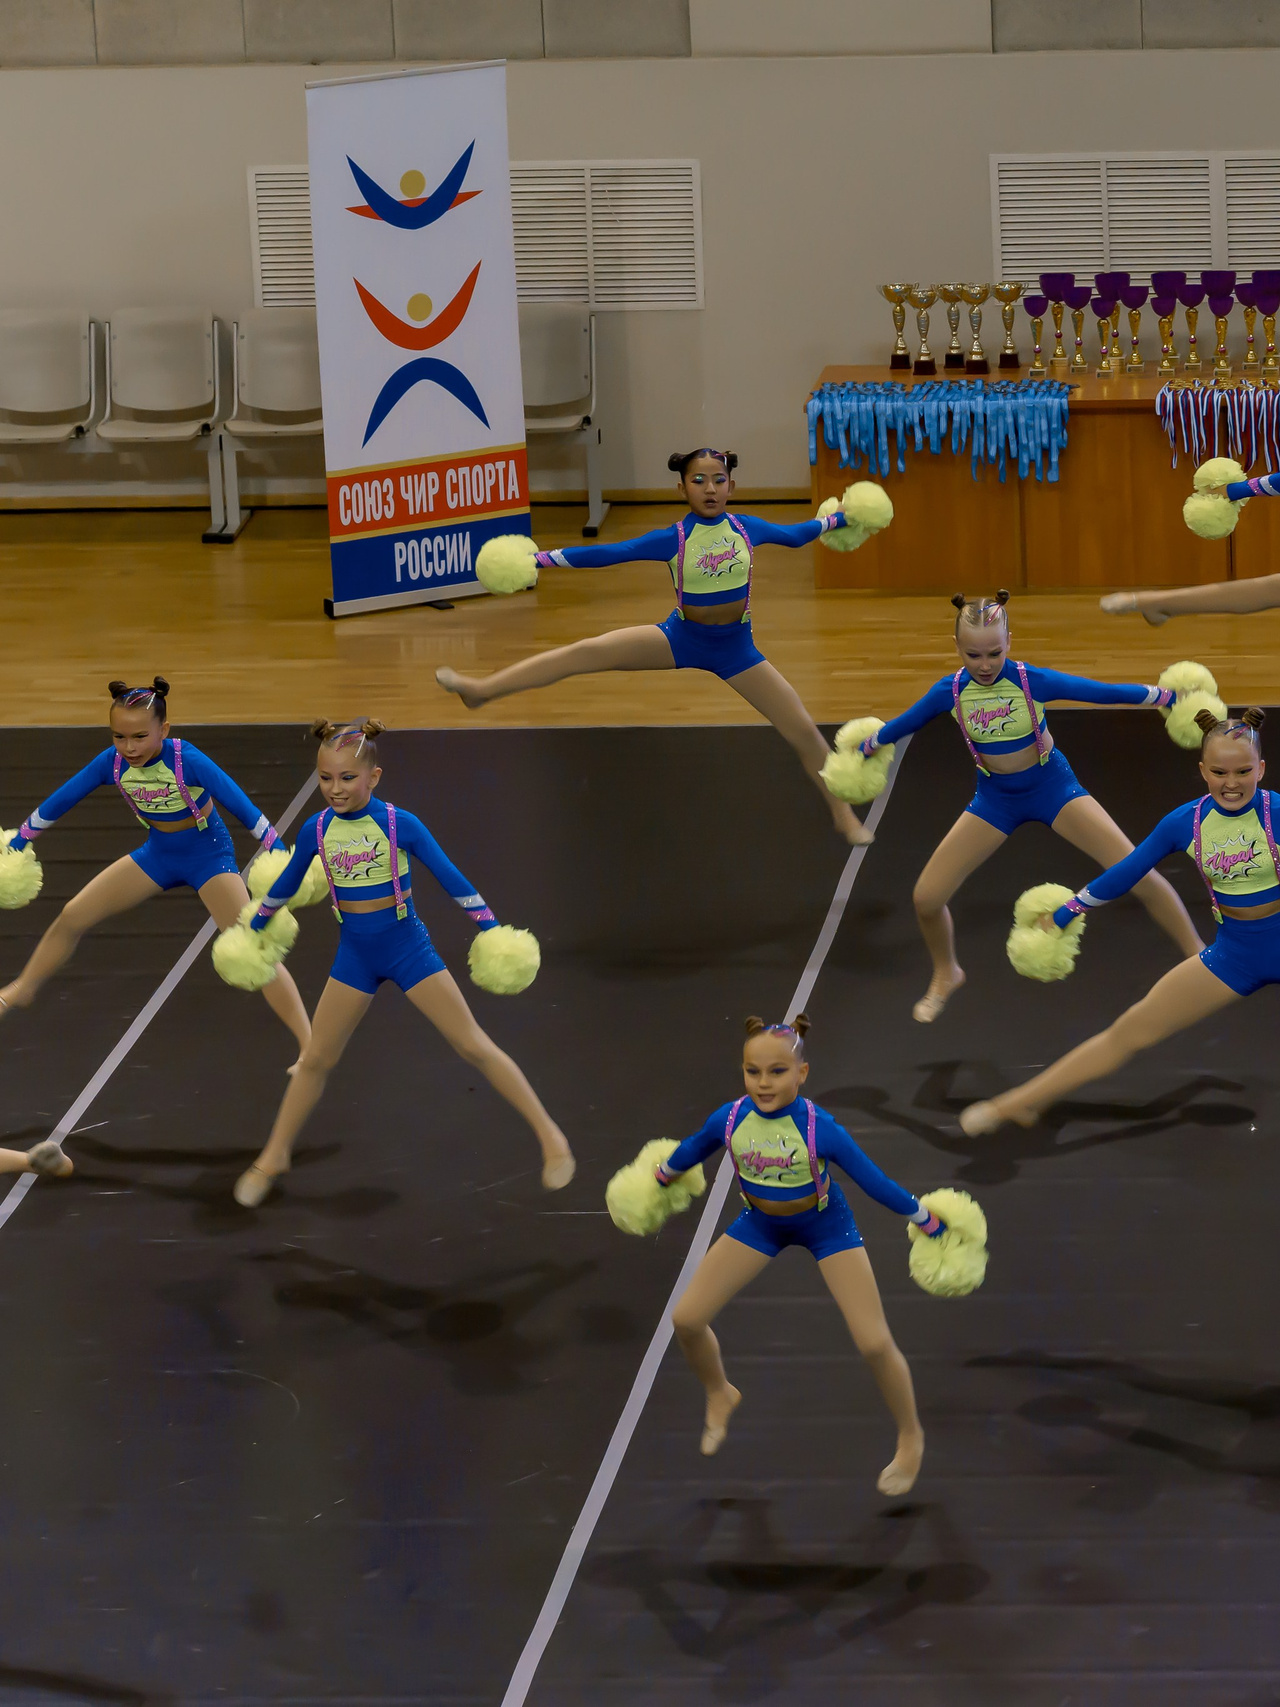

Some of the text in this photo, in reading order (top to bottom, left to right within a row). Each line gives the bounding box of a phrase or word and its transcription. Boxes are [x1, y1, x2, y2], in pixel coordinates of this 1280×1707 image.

[338, 459, 520, 526] СОЮЗ ЧИР СПОРТА
[394, 531, 472, 583] РОССИИ
